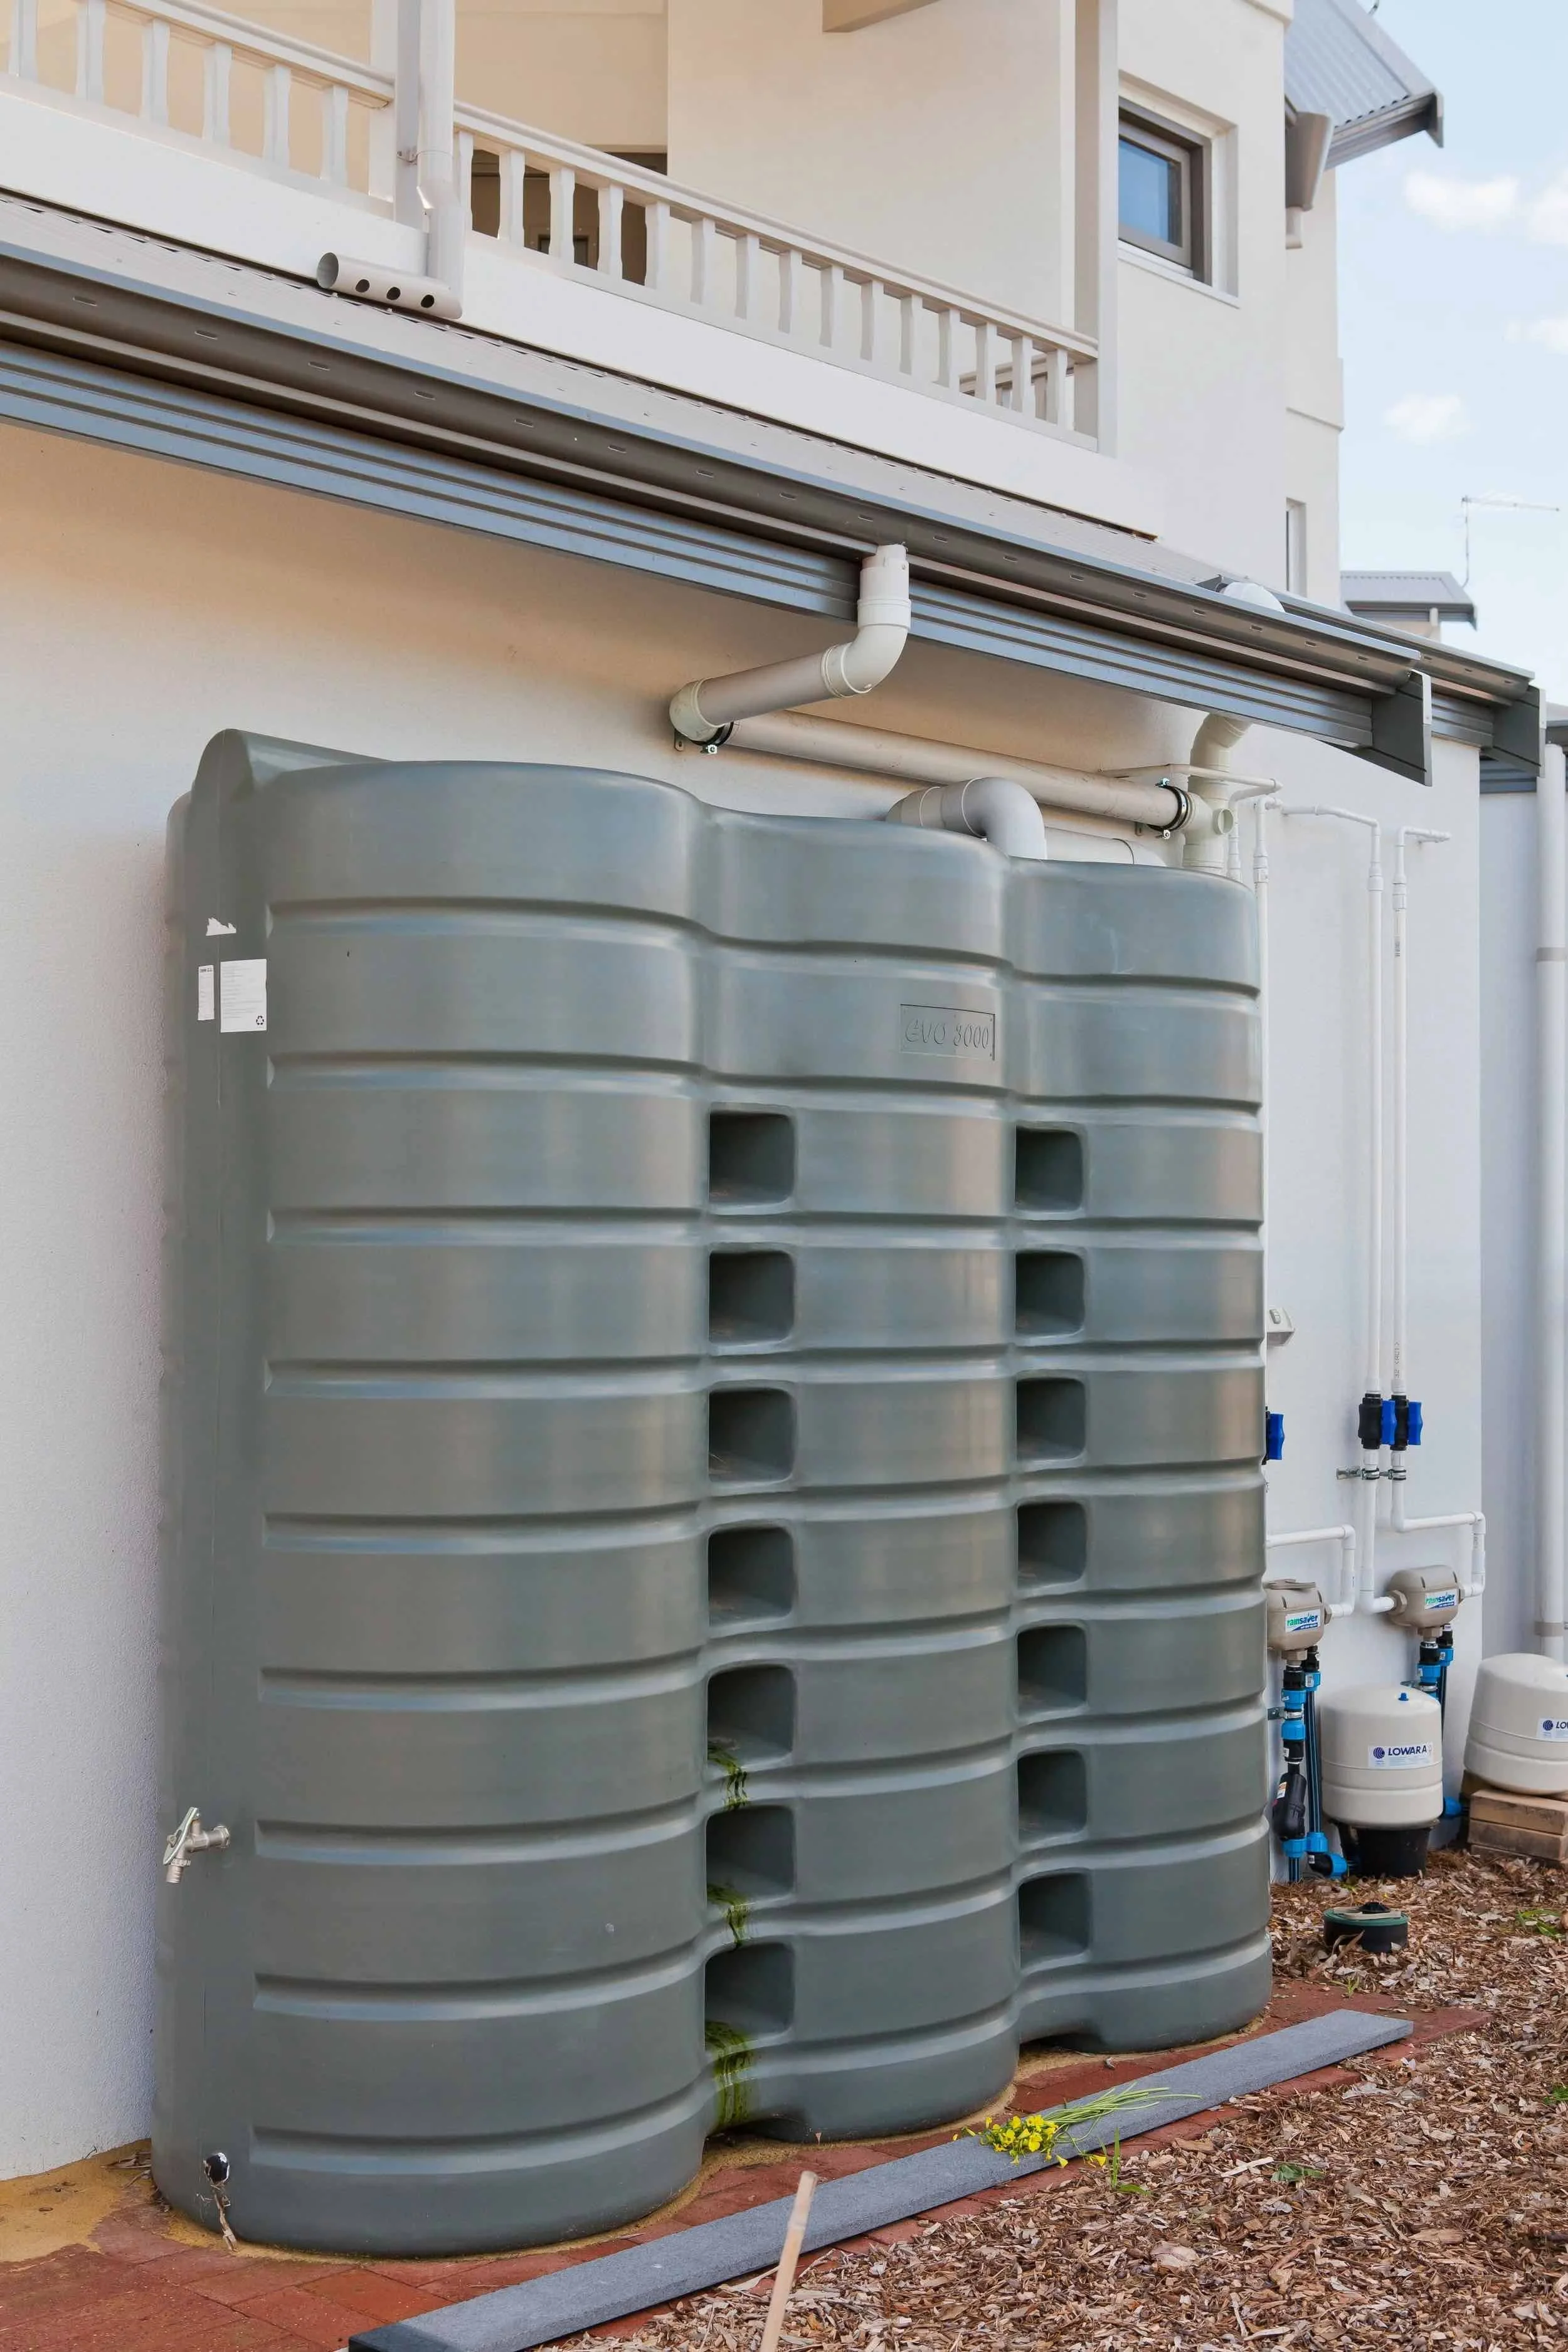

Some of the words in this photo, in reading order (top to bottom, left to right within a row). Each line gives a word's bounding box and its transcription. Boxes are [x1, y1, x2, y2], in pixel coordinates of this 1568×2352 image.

[1287, 1614, 1318, 1626] rainsaver
[1555, 1721, 1568, 1729] LO
[1388, 1745, 1427, 1756] LOWARA
